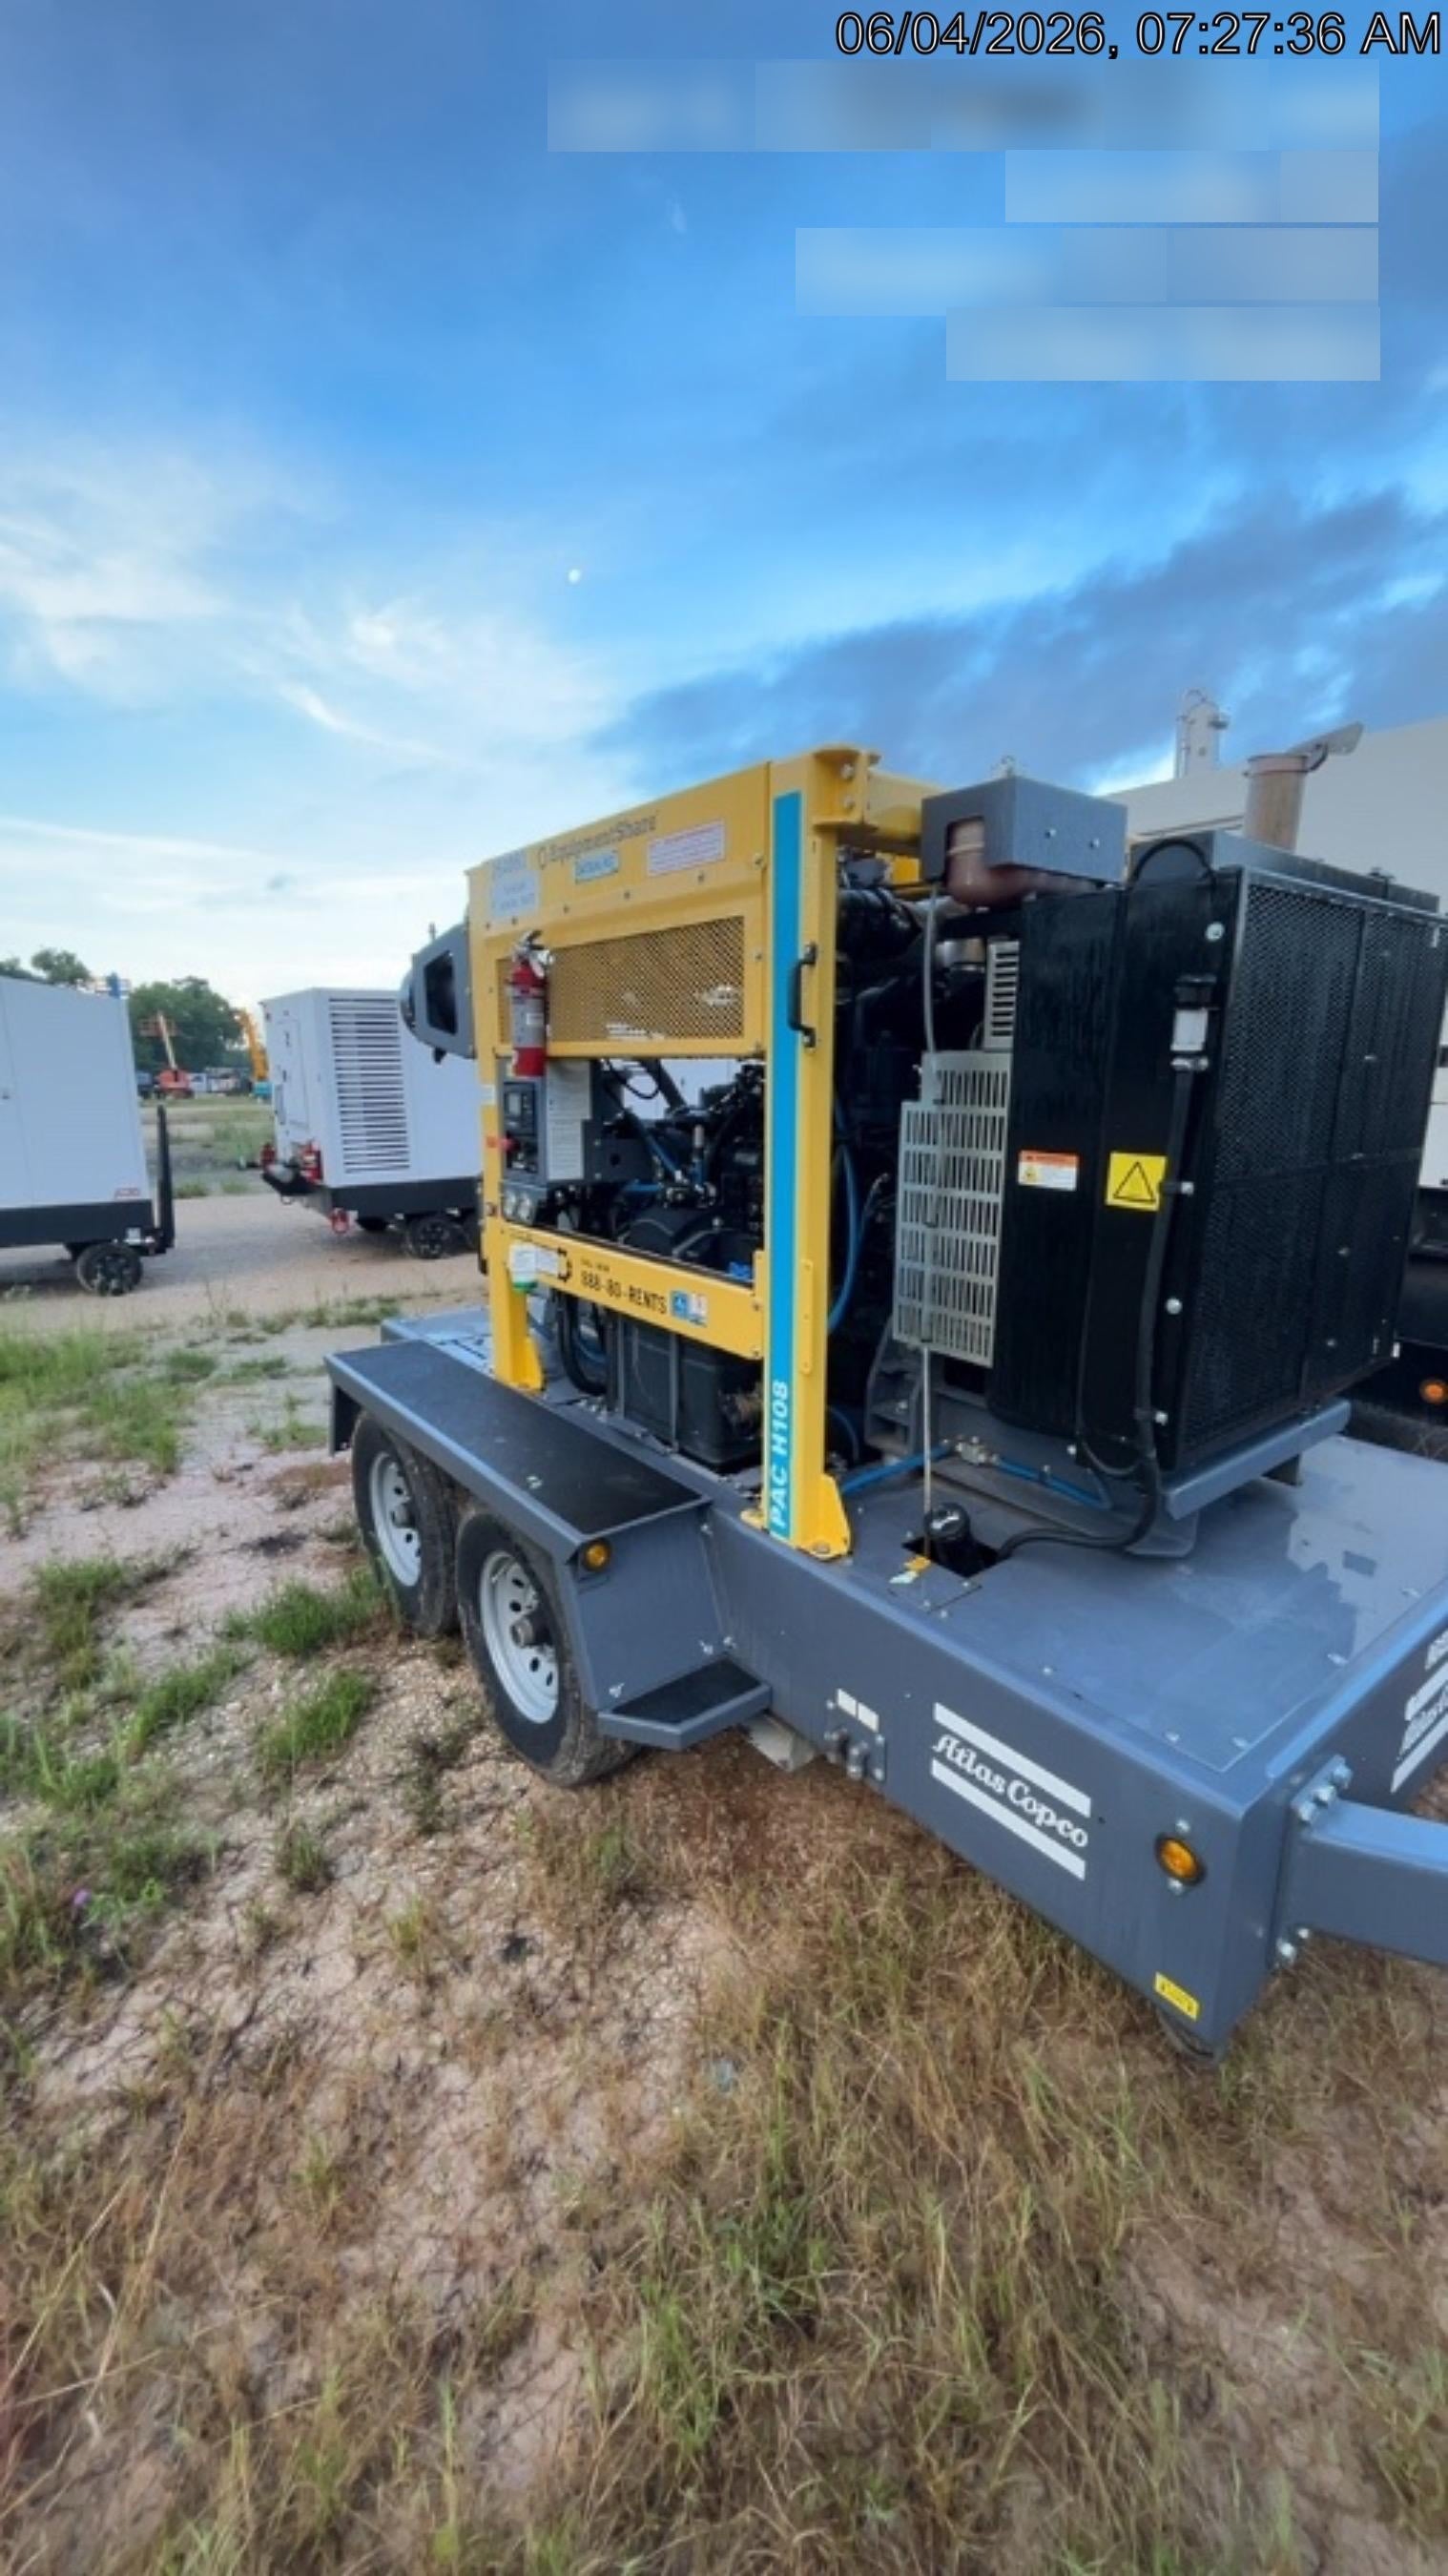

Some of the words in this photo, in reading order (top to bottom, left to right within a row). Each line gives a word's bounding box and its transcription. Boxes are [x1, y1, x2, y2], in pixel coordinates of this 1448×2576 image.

[772, 1380, 789, 1456] H108
[770, 1464, 788, 1529] PAC
[932, 1734, 1005, 1795] Atlas
[1006, 1779, 1089, 1848] Copco
